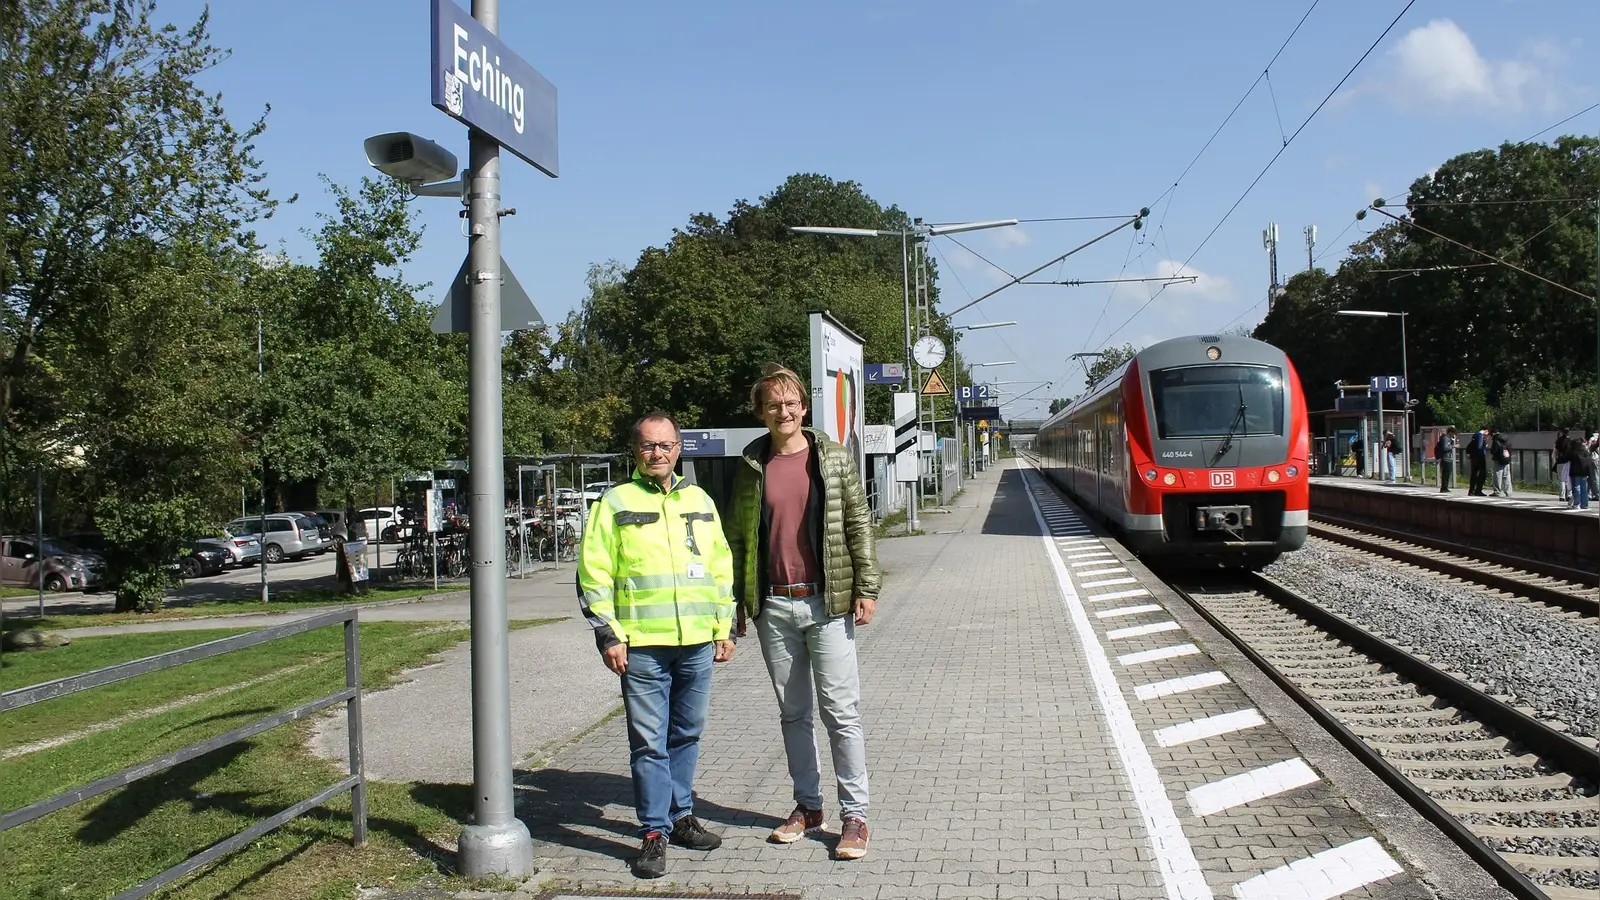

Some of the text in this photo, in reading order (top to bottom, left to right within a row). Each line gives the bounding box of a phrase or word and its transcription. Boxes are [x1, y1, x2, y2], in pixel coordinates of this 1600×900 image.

[454, 22, 524, 134] Eching
[1372, 376, 1398, 389] 1 B
[962, 386, 987, 398] B 2
[1213, 473, 1232, 486] DB
